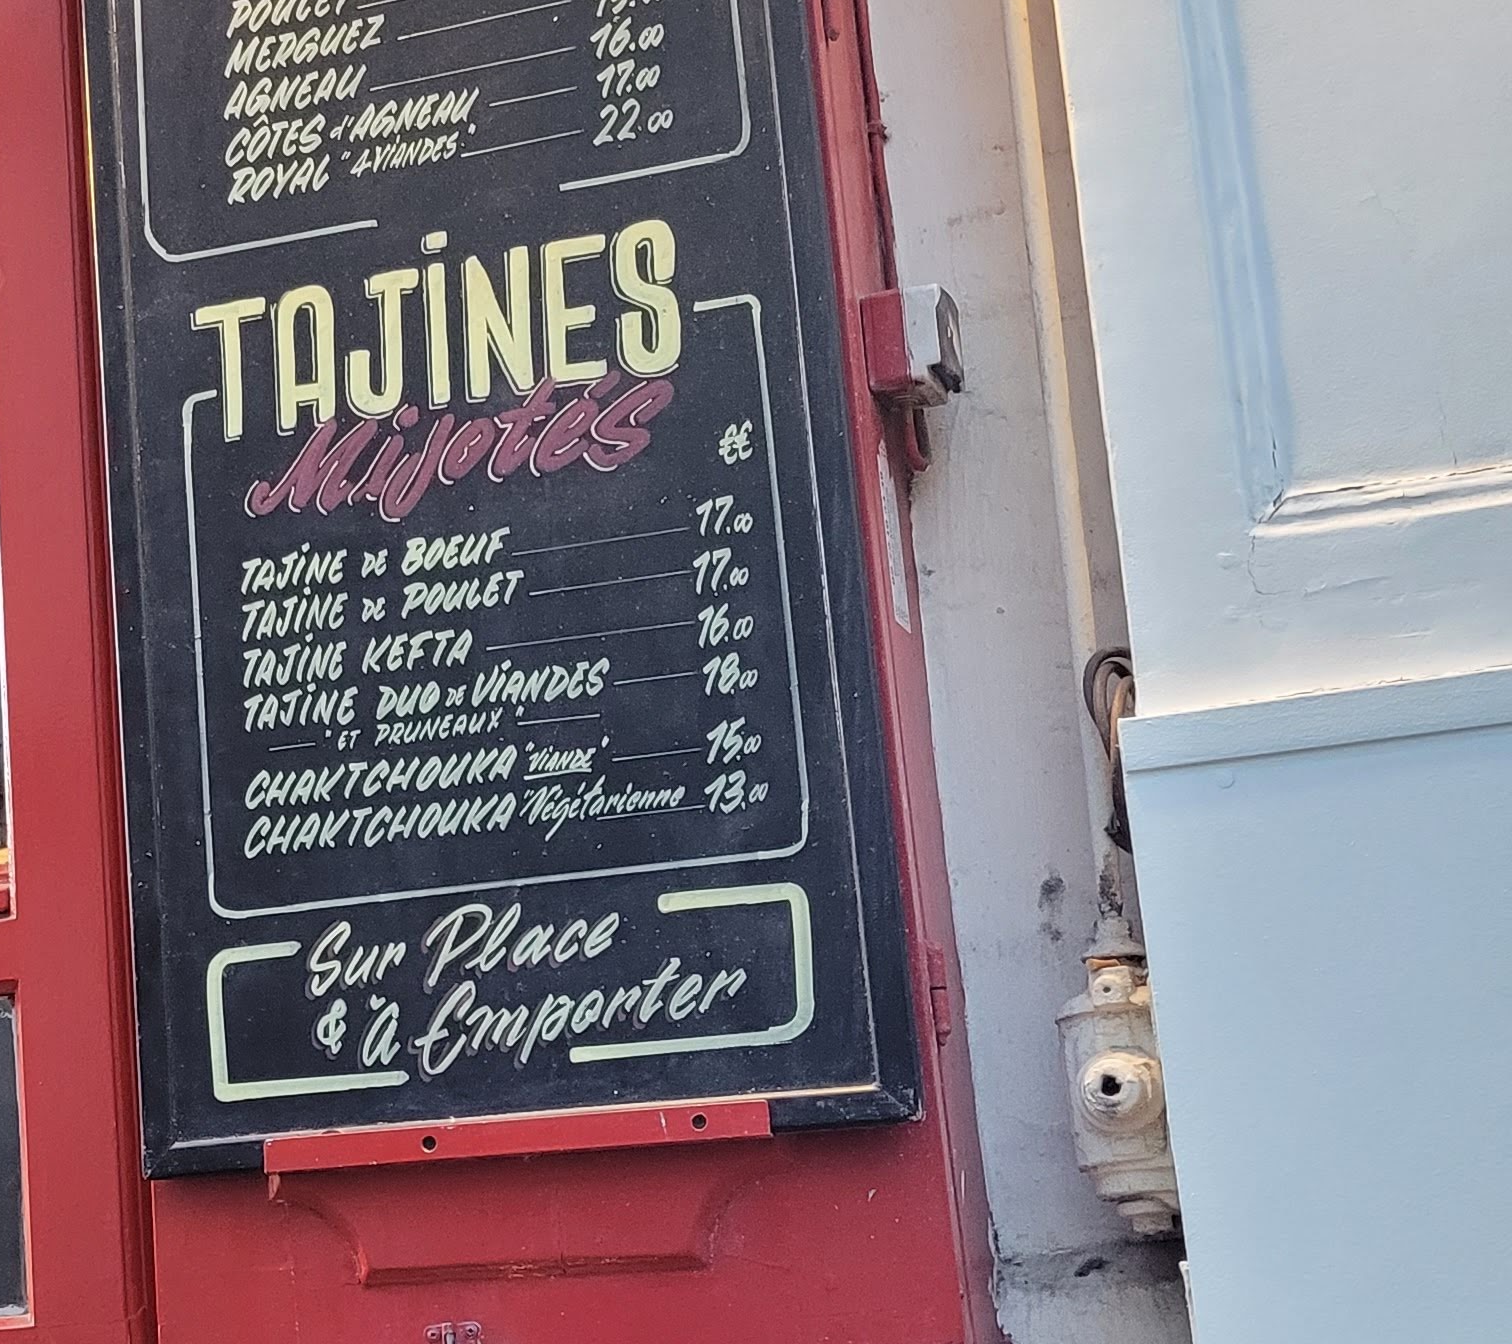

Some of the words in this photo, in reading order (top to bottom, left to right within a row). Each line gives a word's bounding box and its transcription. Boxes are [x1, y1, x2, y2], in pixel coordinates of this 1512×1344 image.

[223, 64, 367, 121] AGNEAU
[590, 17, 664, 59] 16.00
[224, 14, 385, 78] MERGUEZ
[225, 114, 326, 167] CÔTES
[329, 87, 480, 143] d'AGNEAU
[596, 59, 661, 98] 17.00
[227, 154, 331, 205] ROYAL
[593, 98, 673, 146] 22.00
[243, 370, 675, 523] Mijotés
[361, 549, 388, 578] DE
[401, 527, 510, 576] BOEUF
[696, 495, 753, 536] 17.00
[361, 597, 386, 623] DE
[401, 570, 524, 619] POULET
[693, 547, 749, 594] 17.00
[362, 629, 473, 674] KEFTA
[698, 603, 753, 648] 16.00
[376, 681, 440, 721] DUO
[445, 685, 466, 708] DE
[244, 743, 518, 810] CHAKTCHOUKA
[244, 791, 518, 858] CHAKTCHOUKA
[704, 769, 769, 814] 13.00
[308, 920, 407, 998] Sur
[424, 902, 620, 989] Place
[316, 998, 348, 1055] &
[360, 994, 402, 1068] à
[413, 957, 748, 1076] Emporter
